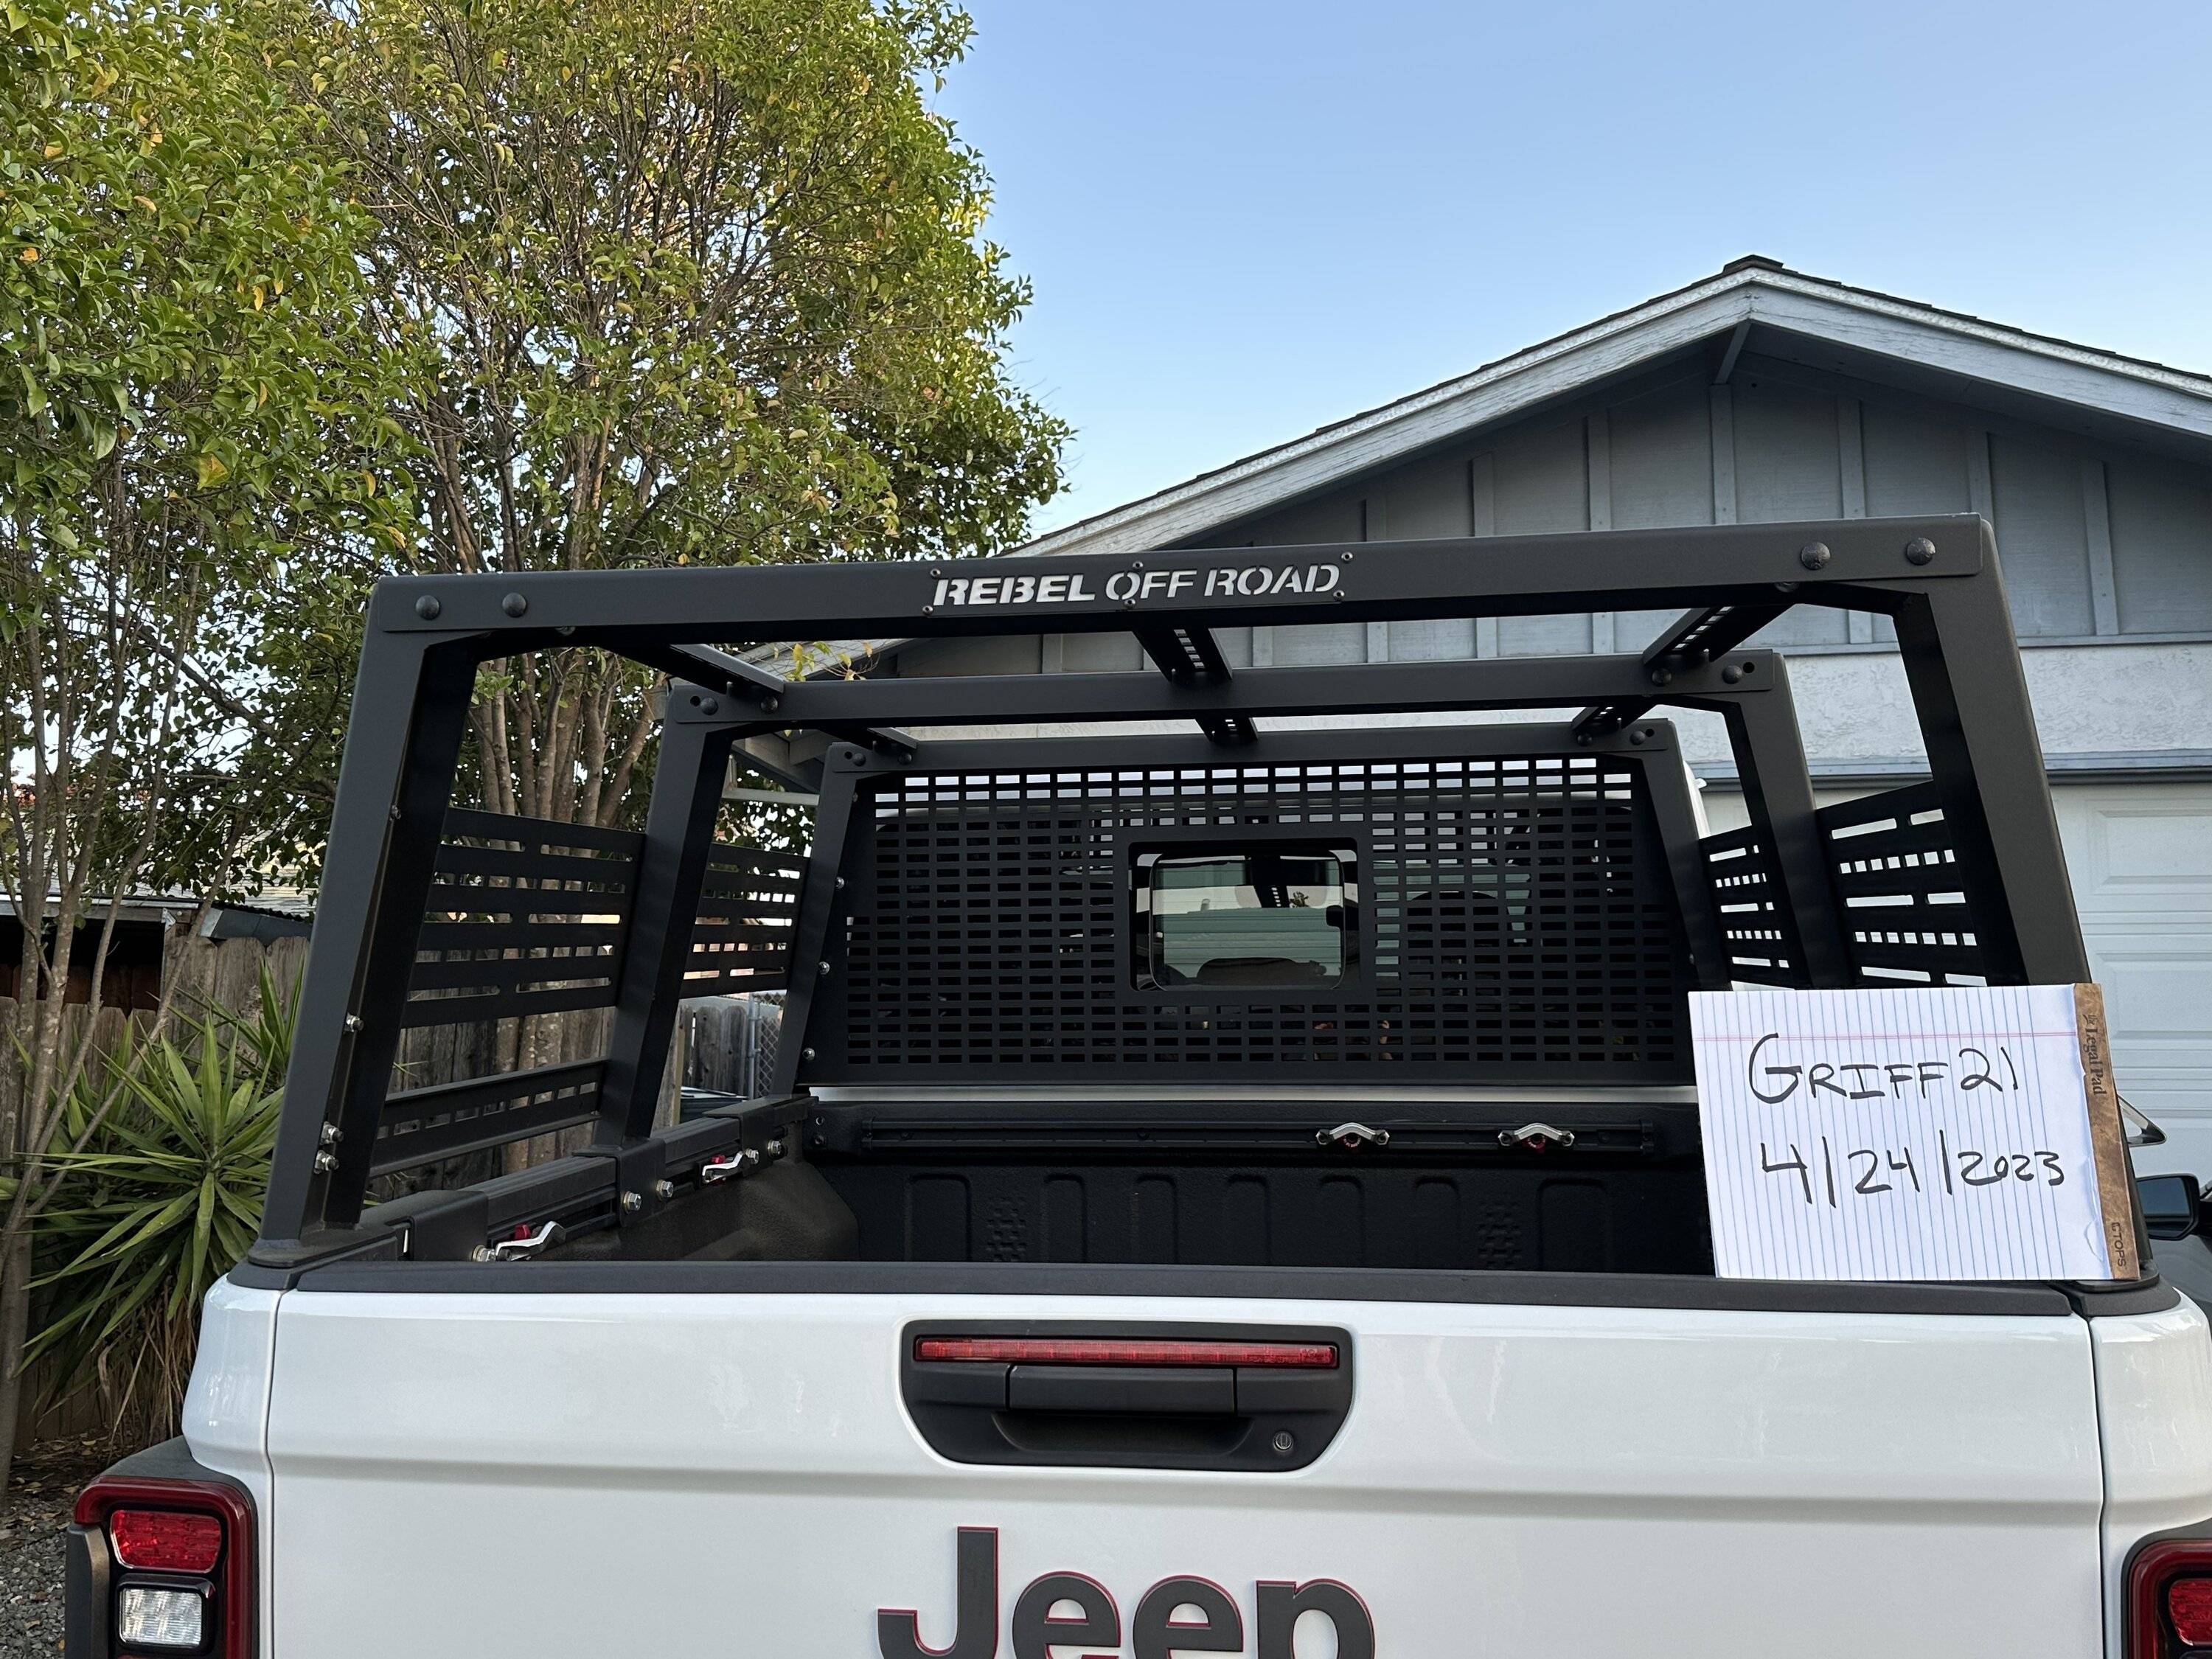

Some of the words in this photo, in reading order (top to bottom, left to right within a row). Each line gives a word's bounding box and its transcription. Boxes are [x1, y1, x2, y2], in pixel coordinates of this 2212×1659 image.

[933, 574, 1096, 606] REBEL
[1105, 568, 1197, 601] OFF
[1204, 564, 1340, 597] ROAD
[2083, 1028, 2103, 1064] Legal
[2090, 1068, 2107, 1095] Pad
